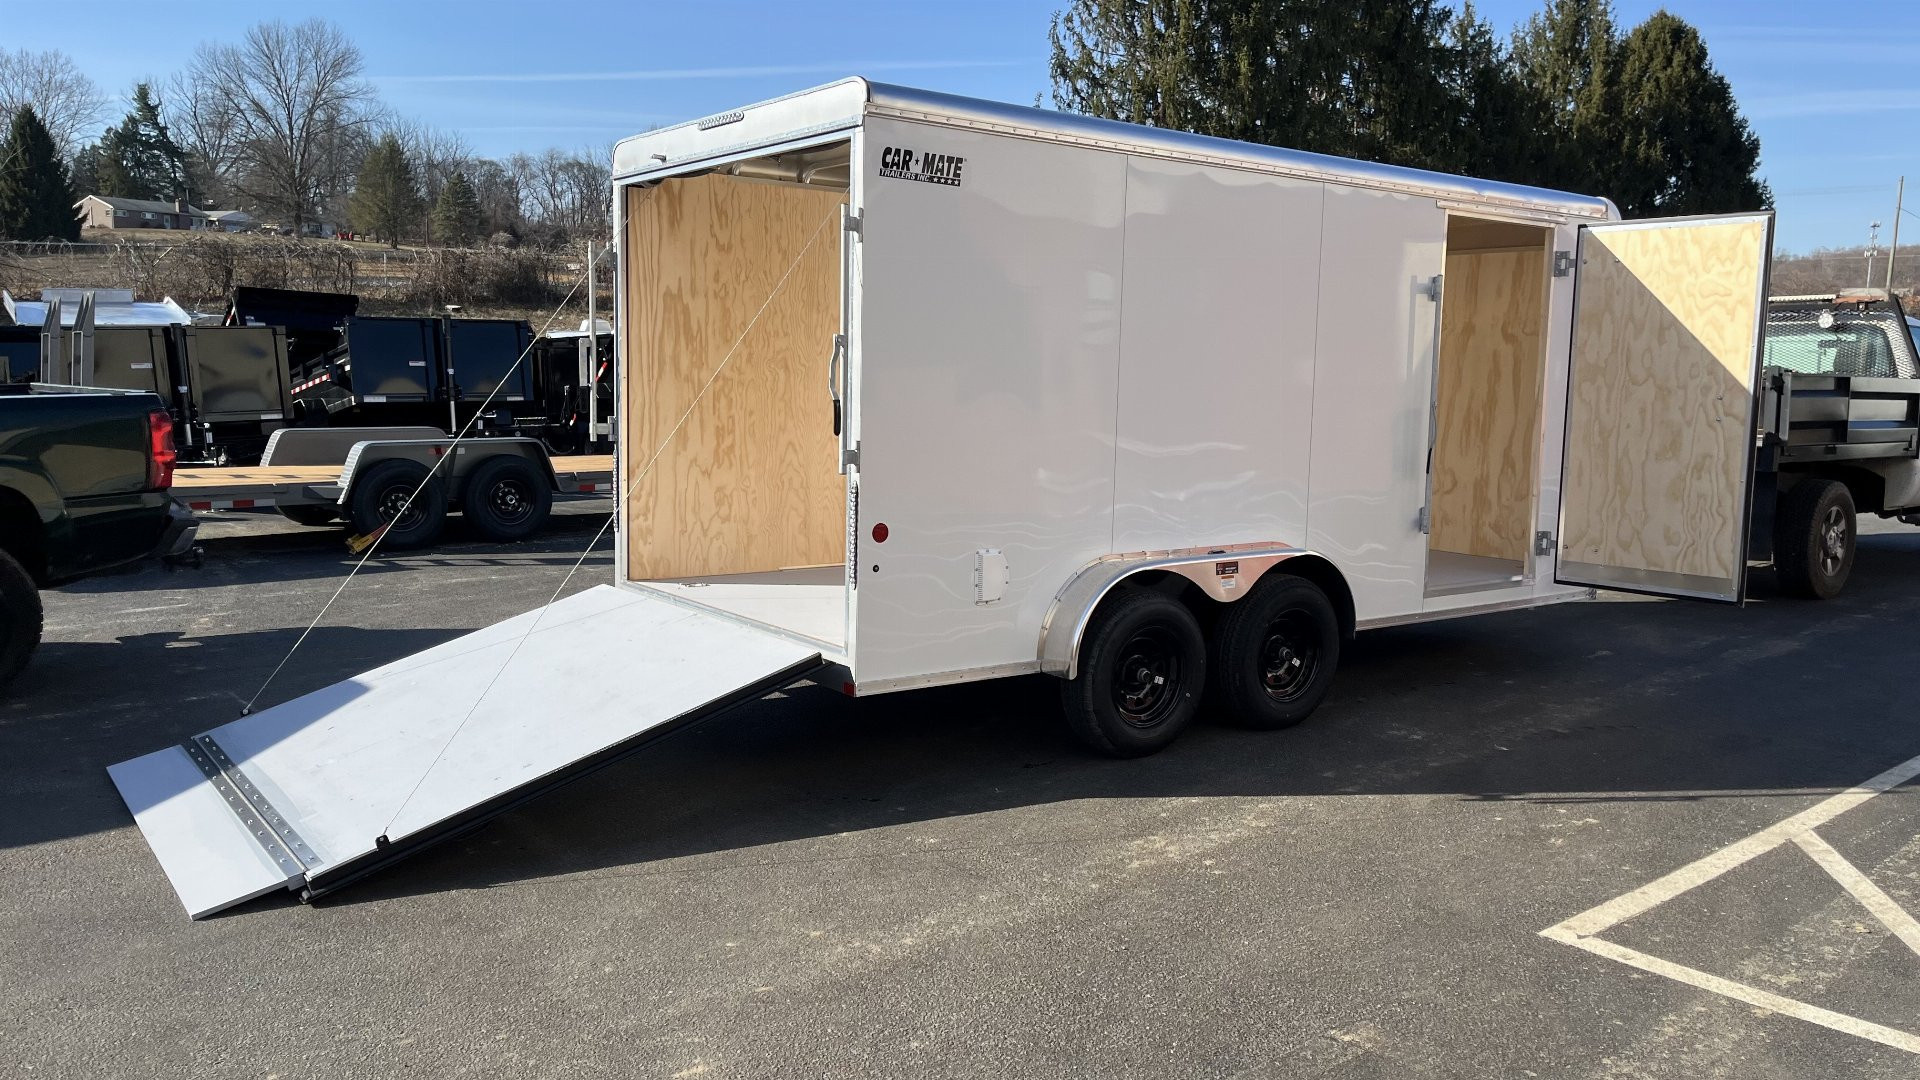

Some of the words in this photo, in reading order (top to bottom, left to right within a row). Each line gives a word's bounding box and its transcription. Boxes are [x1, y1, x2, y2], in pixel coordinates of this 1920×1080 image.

[882, 147, 913, 171] CAR
[922, 152, 963, 178] MATE
[881, 169, 916, 180] TRAILERS
